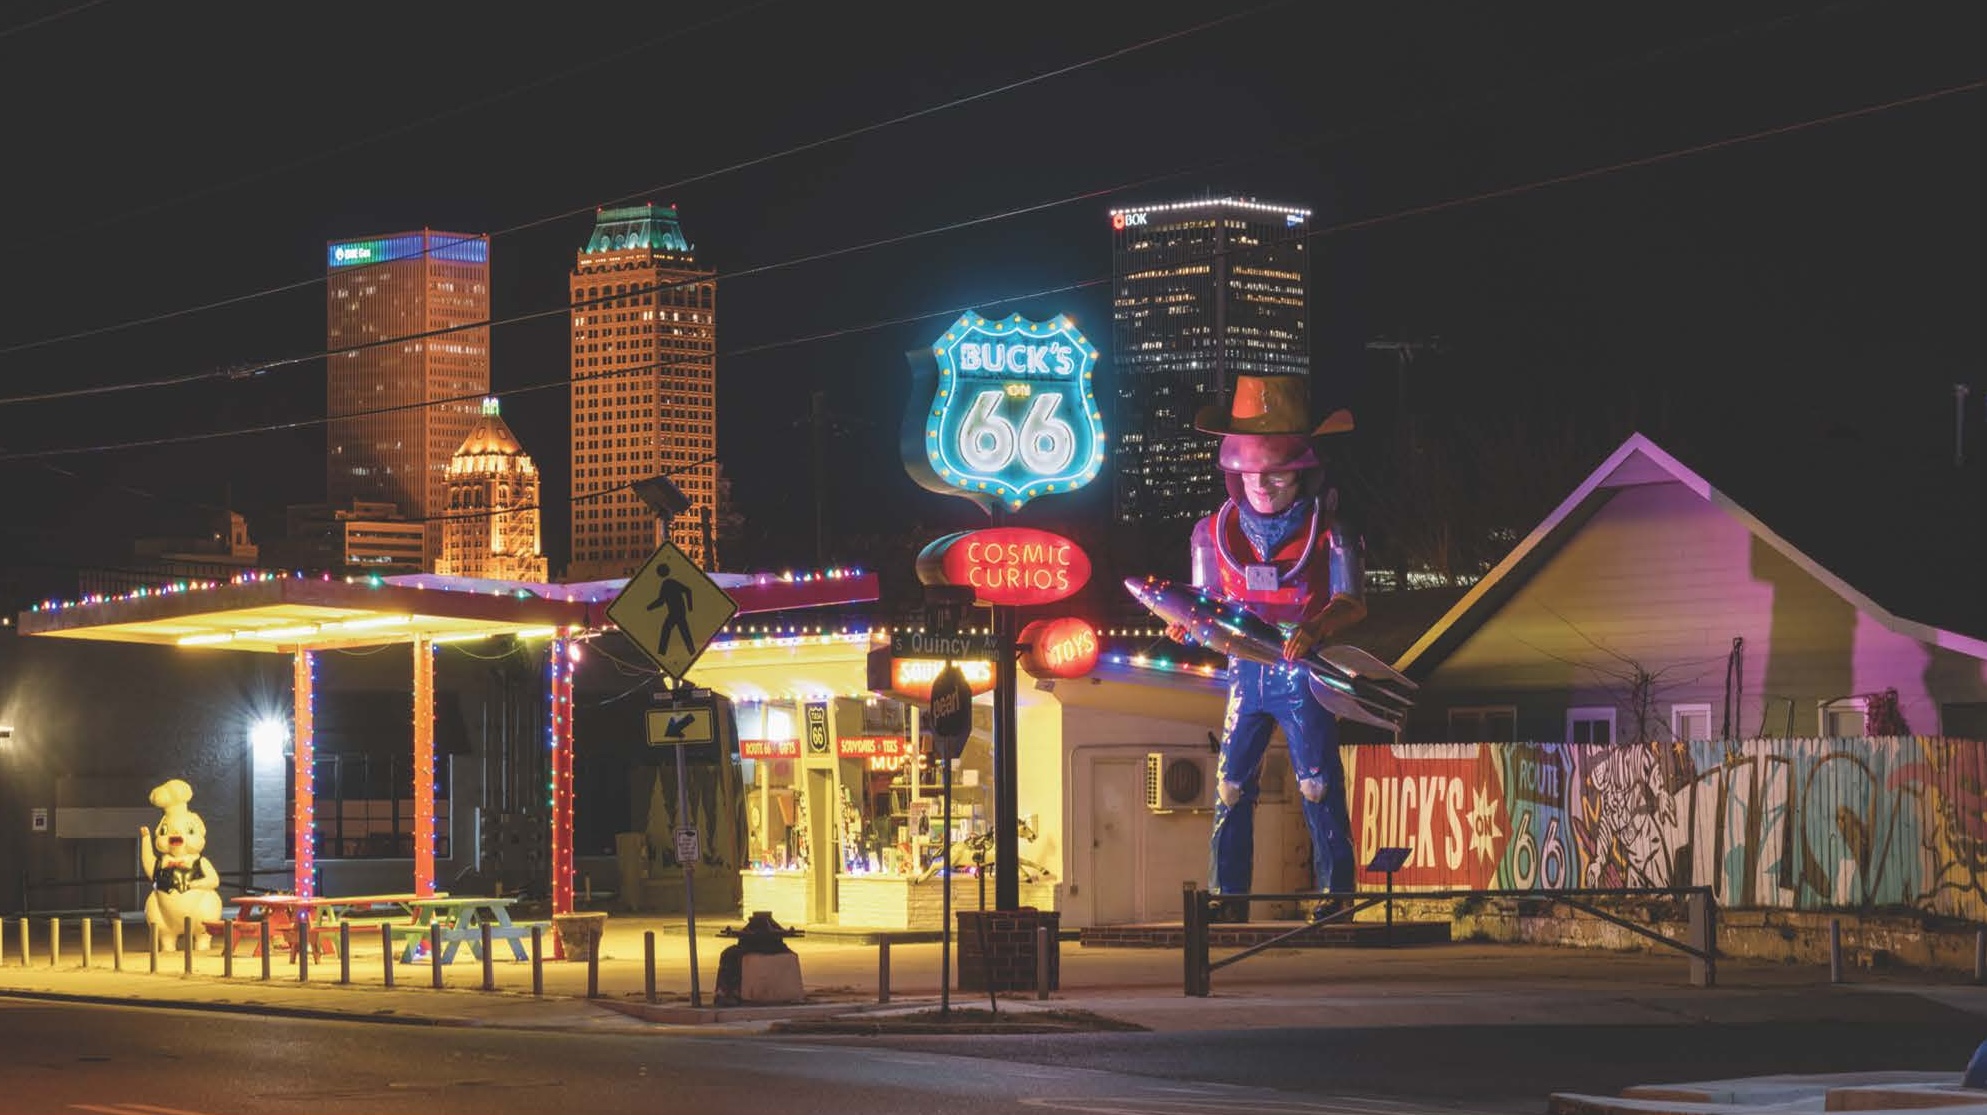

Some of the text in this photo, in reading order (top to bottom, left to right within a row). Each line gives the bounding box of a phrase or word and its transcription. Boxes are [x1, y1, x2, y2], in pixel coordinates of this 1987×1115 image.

[1125, 213, 1147, 226] BOK
[960, 342, 1075, 375] BUCK'S
[1005, 383, 1031, 397] ON
[957, 390, 1076, 476] 66
[968, 542, 1071, 566] COSMIC
[969, 566, 1069, 590] CURIOS
[911, 631, 971, 660] Quincy
[1048, 629, 1095, 666] TOYS
[812, 726, 824, 745] 66
[1519, 758, 1560, 799] ROUTE
[1360, 775, 1464, 871] BUCK'S
[1475, 814, 1493, 838] ON
[1512, 809, 1567, 890] 66
